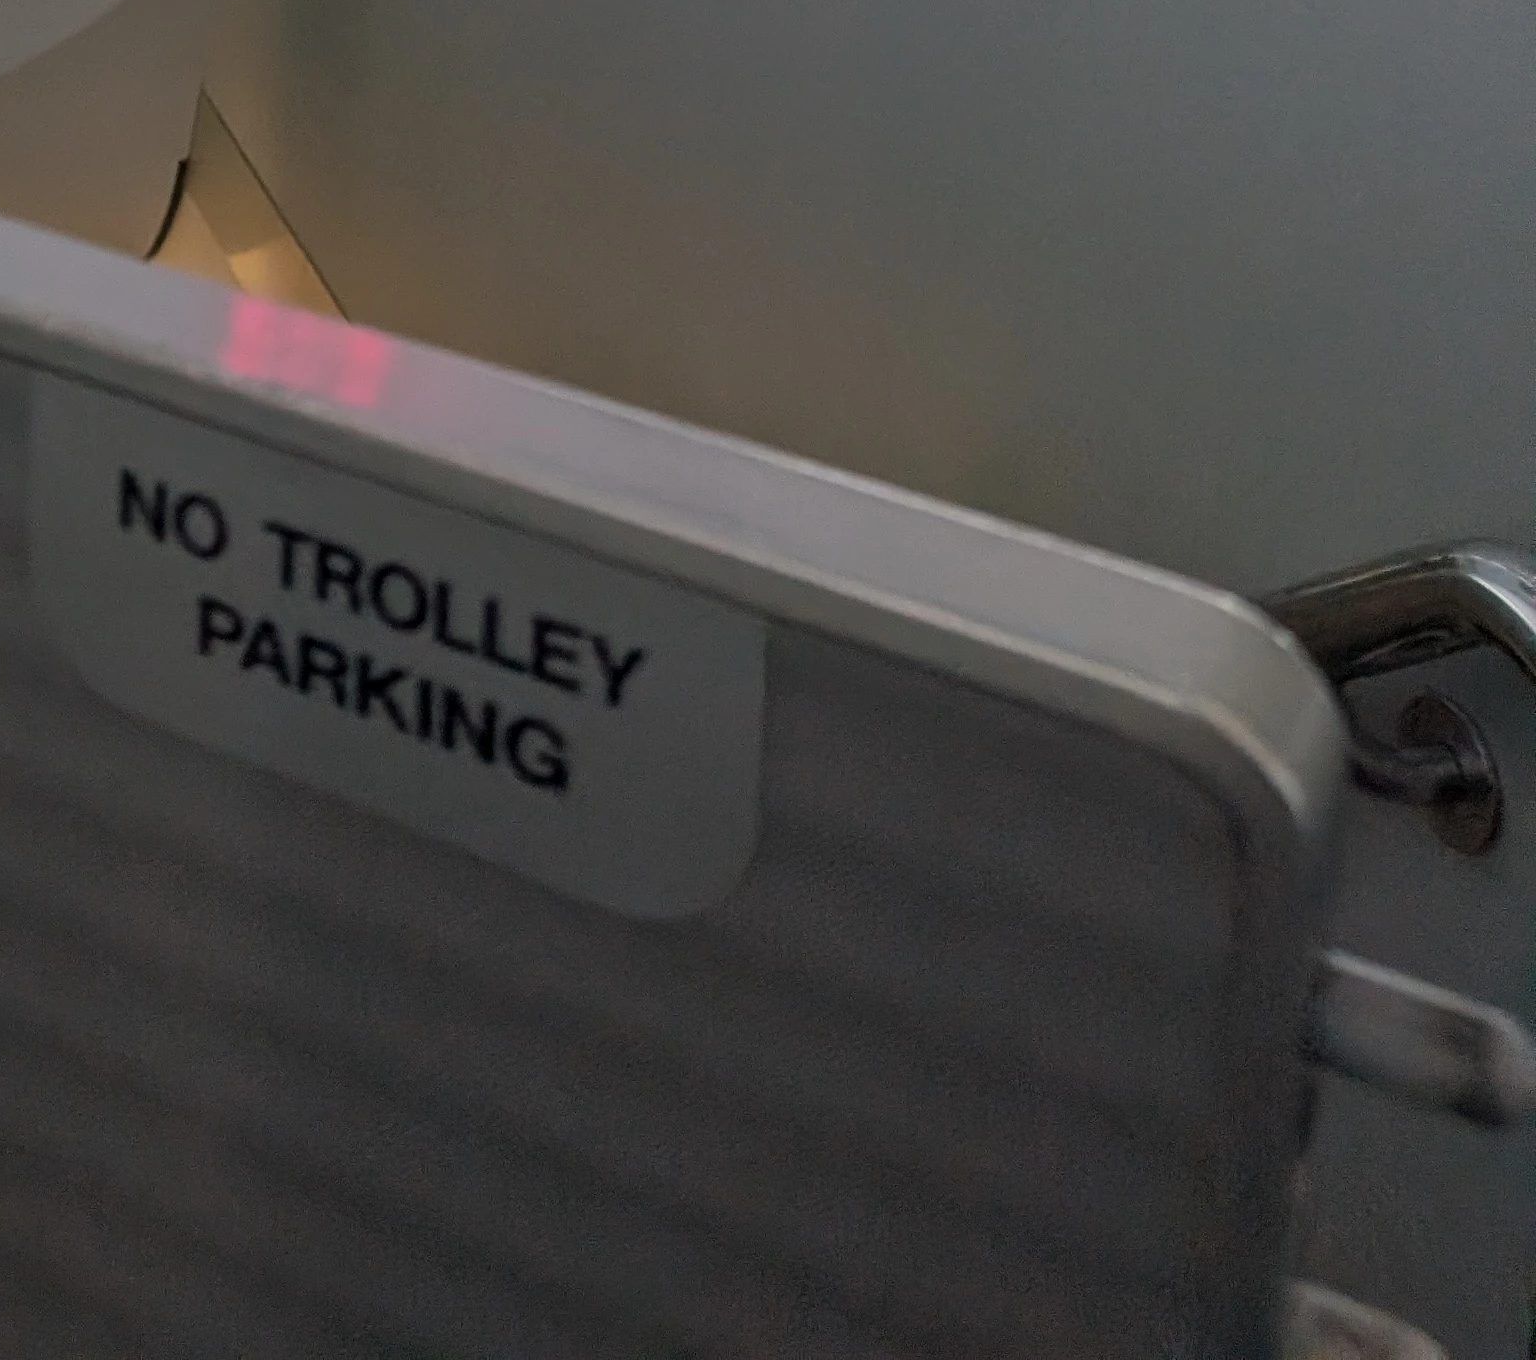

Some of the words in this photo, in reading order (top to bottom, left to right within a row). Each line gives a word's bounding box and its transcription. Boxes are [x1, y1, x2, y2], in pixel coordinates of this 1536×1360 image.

[117, 467, 229, 561] NO
[259, 516, 648, 710] TROLLEY
[195, 595, 572, 794] PARKING
